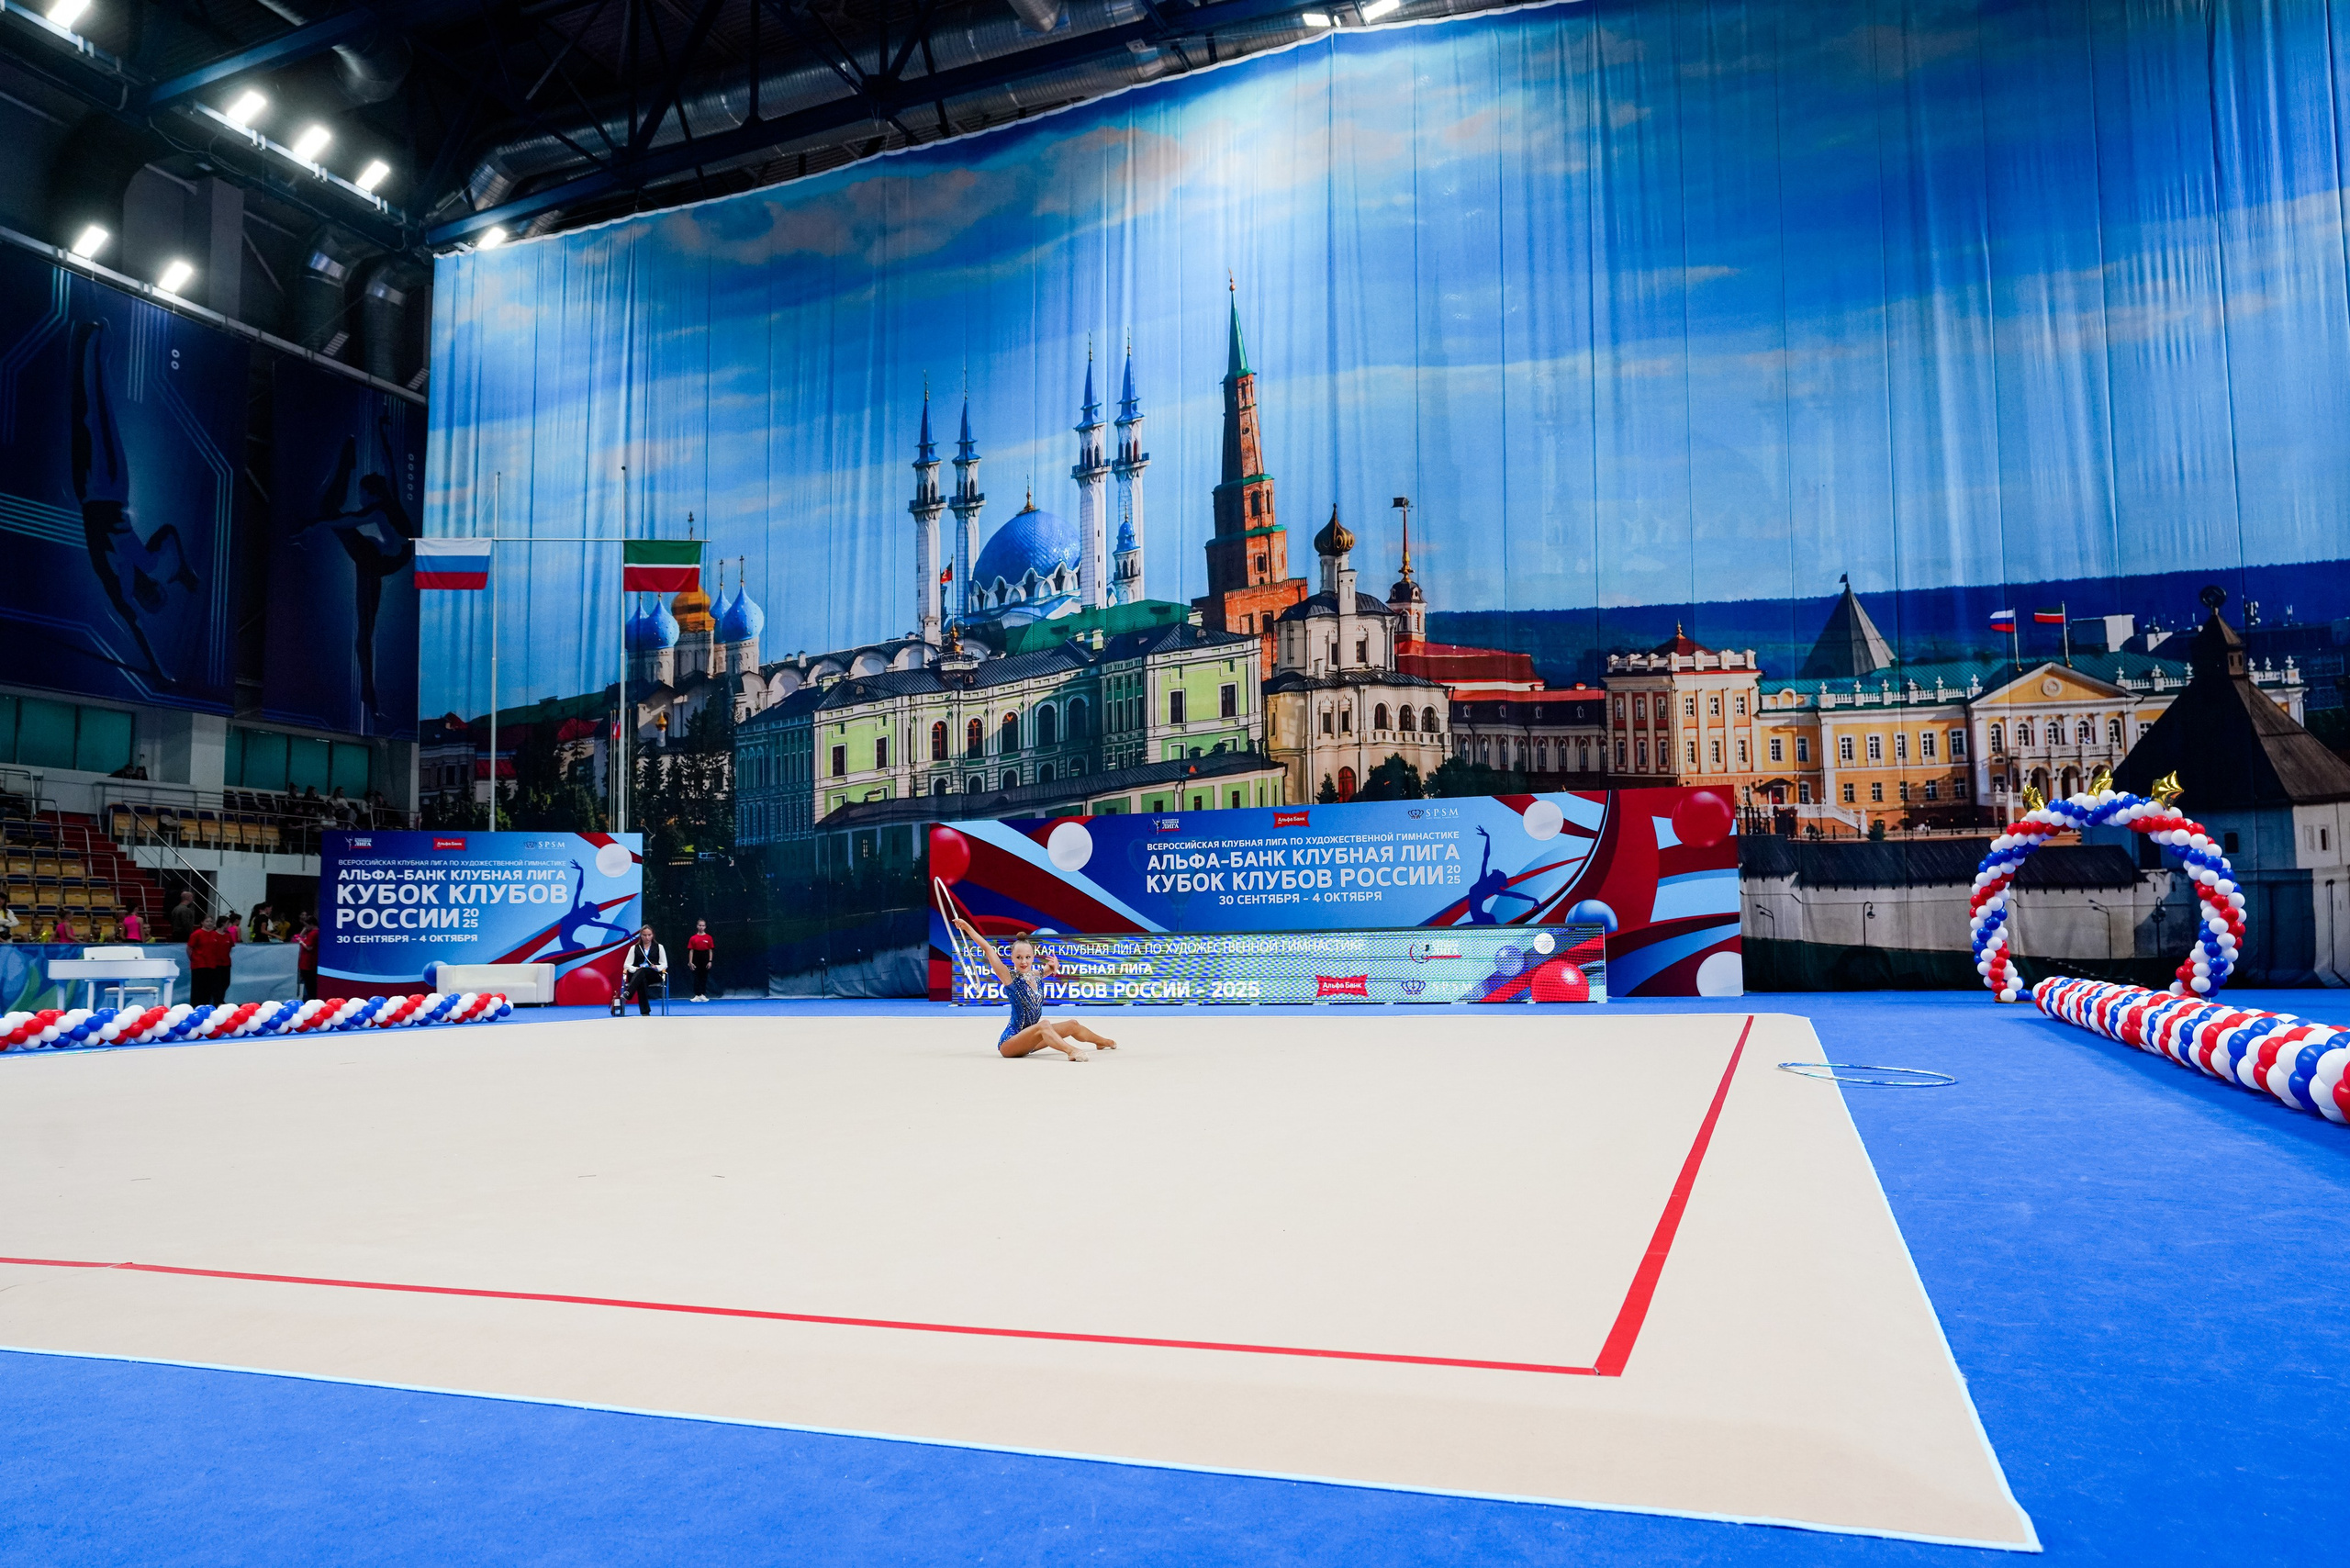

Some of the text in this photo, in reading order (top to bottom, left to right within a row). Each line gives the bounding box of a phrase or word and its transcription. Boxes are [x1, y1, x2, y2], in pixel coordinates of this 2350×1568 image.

[1147, 831, 1460, 851] ВСЕРОССИЙСКАЯ КЛУБНАЯ ЛИГА ПО ХУДОЖЕСТВЕННОЙ ГИМНАСТИКЕ
[1147, 843, 1460, 871] АЛЬФА-БАНК КЛУБНАЯ ЛИГА
[338, 869, 566, 880] АЛЬФА-БАНК КЛУБНАЯ ЛИГА
[1447, 865, 1460, 873] 20
[1147, 865, 1444, 893] КУБОК КЛУБОВ РОССИИ
[1447, 876, 1460, 884] 25
[337, 884, 568, 904] КУБОК КЛУБОВ
[1219, 895, 1234, 905] 30
[1237, 893, 1300, 904] СЕНТЯБРЯ
[1312, 893, 1320, 902] 4
[1324, 891, 1382, 902] ОКТЯБРЯ
[336, 908, 479, 929] РОССИИ 20
[463, 919, 479, 928] 25
[352, 935, 408, 944] СЕНТЯБРЯ
[419, 935, 427, 943] 4
[430, 934, 478, 943] ОКТЯБРЯ
[1058, 945, 1109, 956] КЛУБНАЯ
[1113, 945, 1140, 955] ЛИГА
[1145, 944, 1162, 954] ПО
[1166, 940, 1277, 955] ХУДОЖЕСТВЕННОЙ
[1119, 964, 1153, 974] ЛИГА
[1044, 982, 1107, 999] ЛУБОВ
[1113, 981, 1191, 998] РОССИИ
[1211, 981, 1259, 998] 2025
